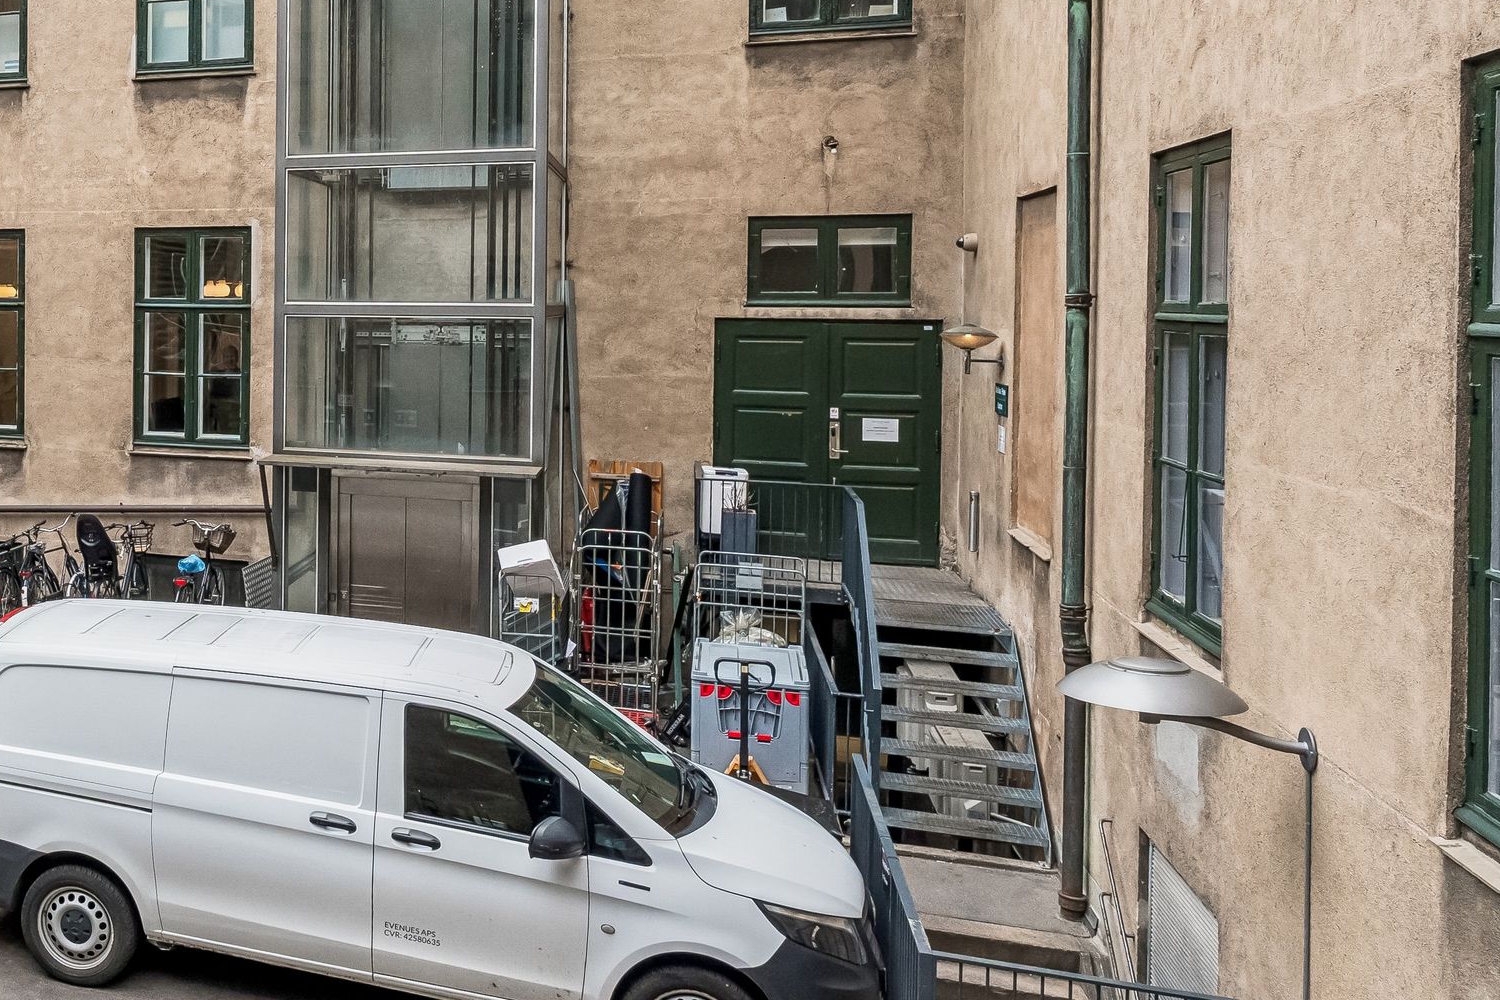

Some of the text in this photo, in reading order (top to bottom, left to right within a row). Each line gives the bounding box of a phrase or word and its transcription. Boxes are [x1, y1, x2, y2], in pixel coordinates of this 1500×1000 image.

[384, 921, 436, 938] EVENUES APS
[384, 929, 441, 947] CVR: 42580635
